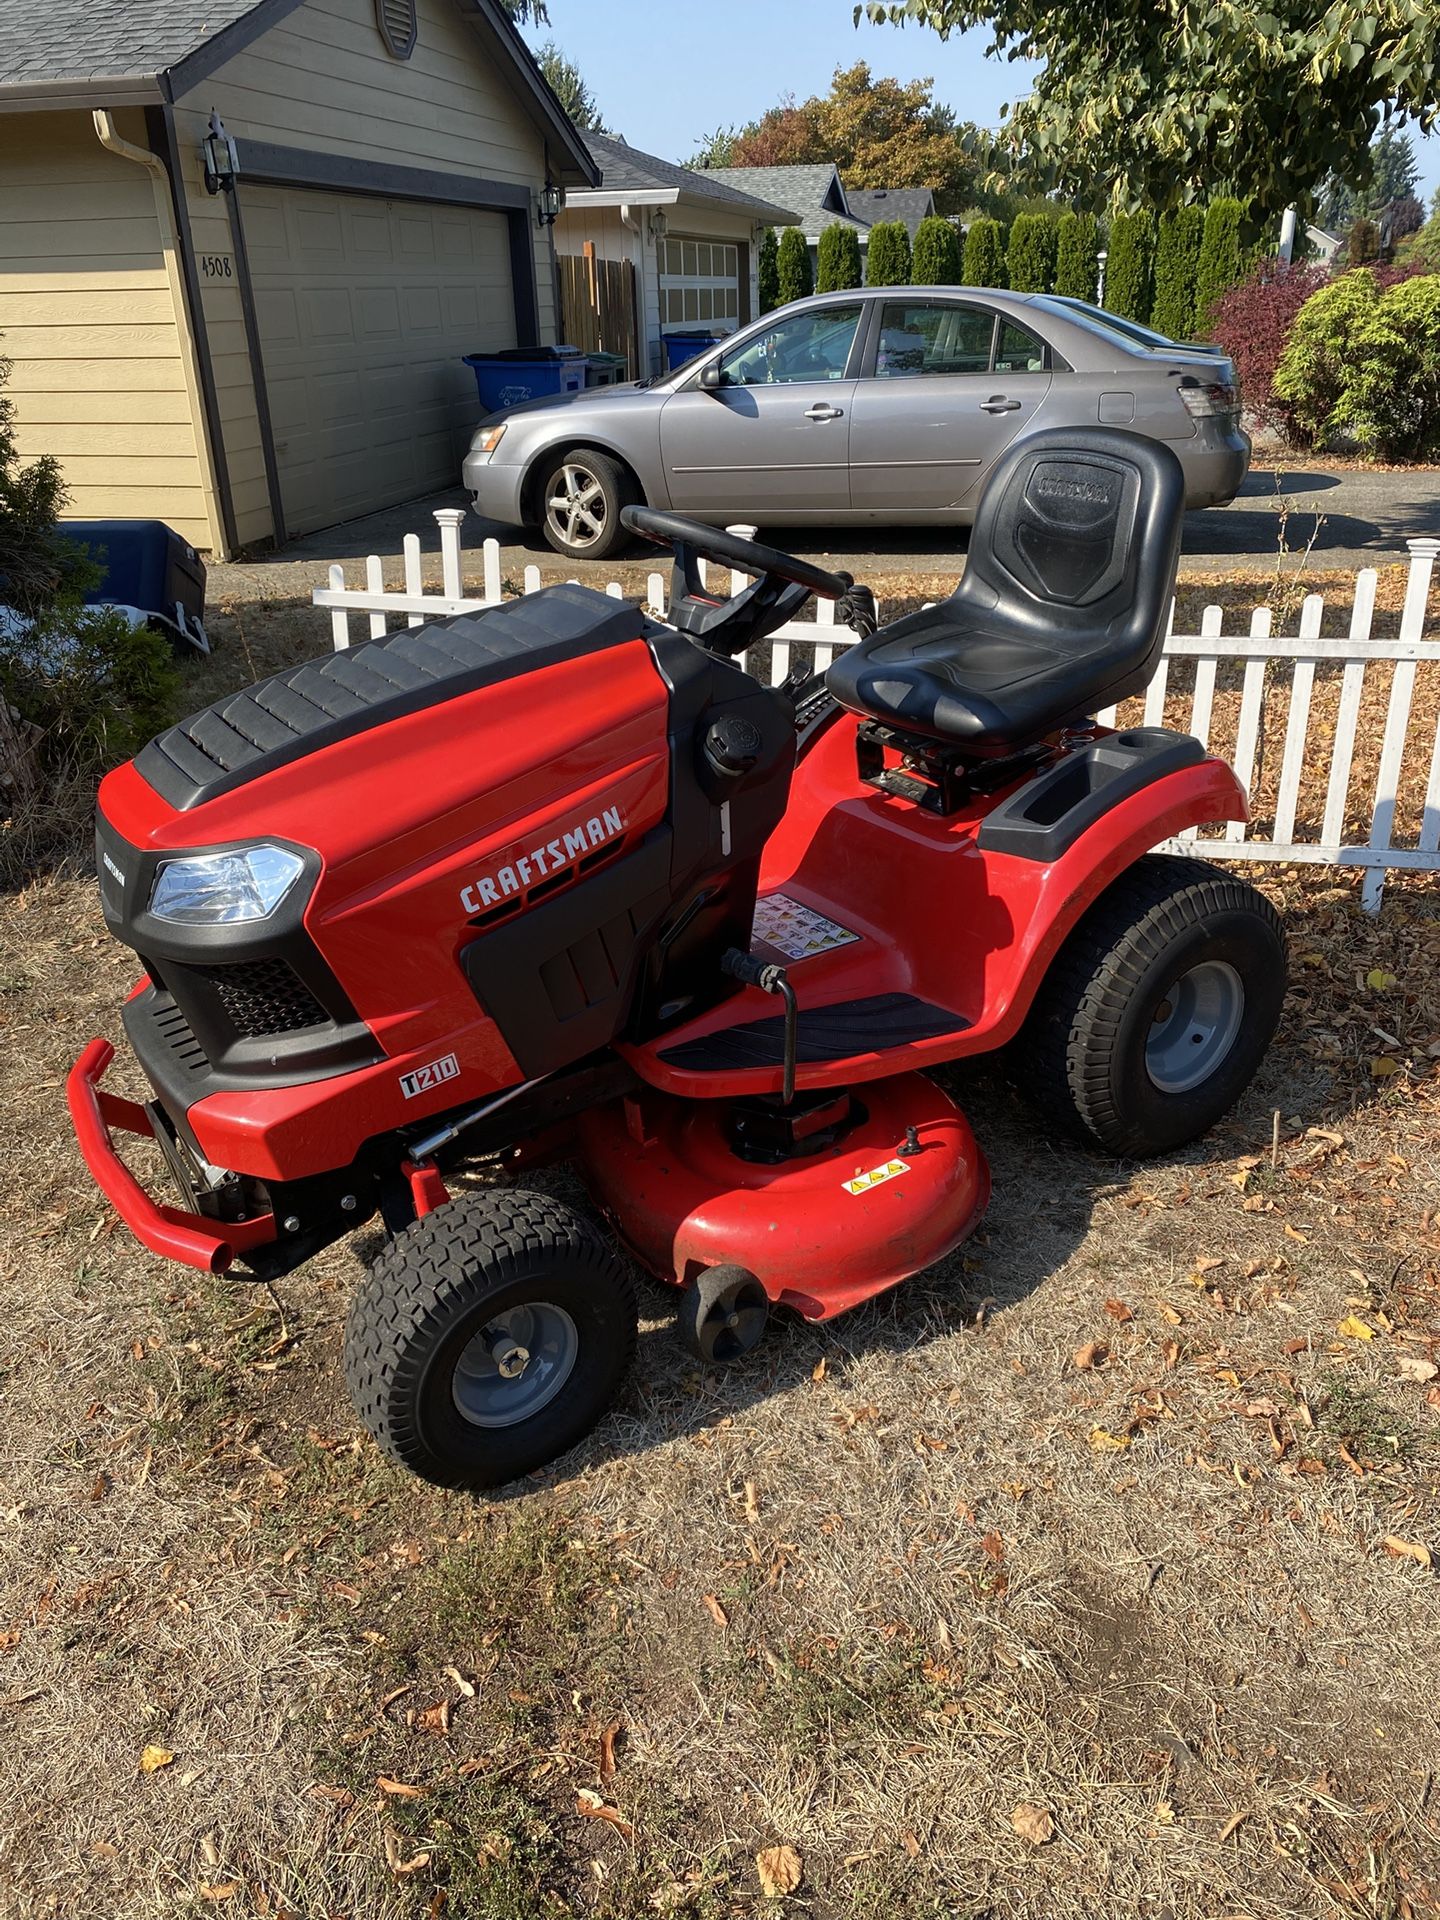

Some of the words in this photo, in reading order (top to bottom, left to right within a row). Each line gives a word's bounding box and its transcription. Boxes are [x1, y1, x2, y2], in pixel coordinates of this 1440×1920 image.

[202, 256, 232, 277] 4508
[459, 805, 623, 914] CRAFTSMAN
[401, 1056, 458, 1094] T210
